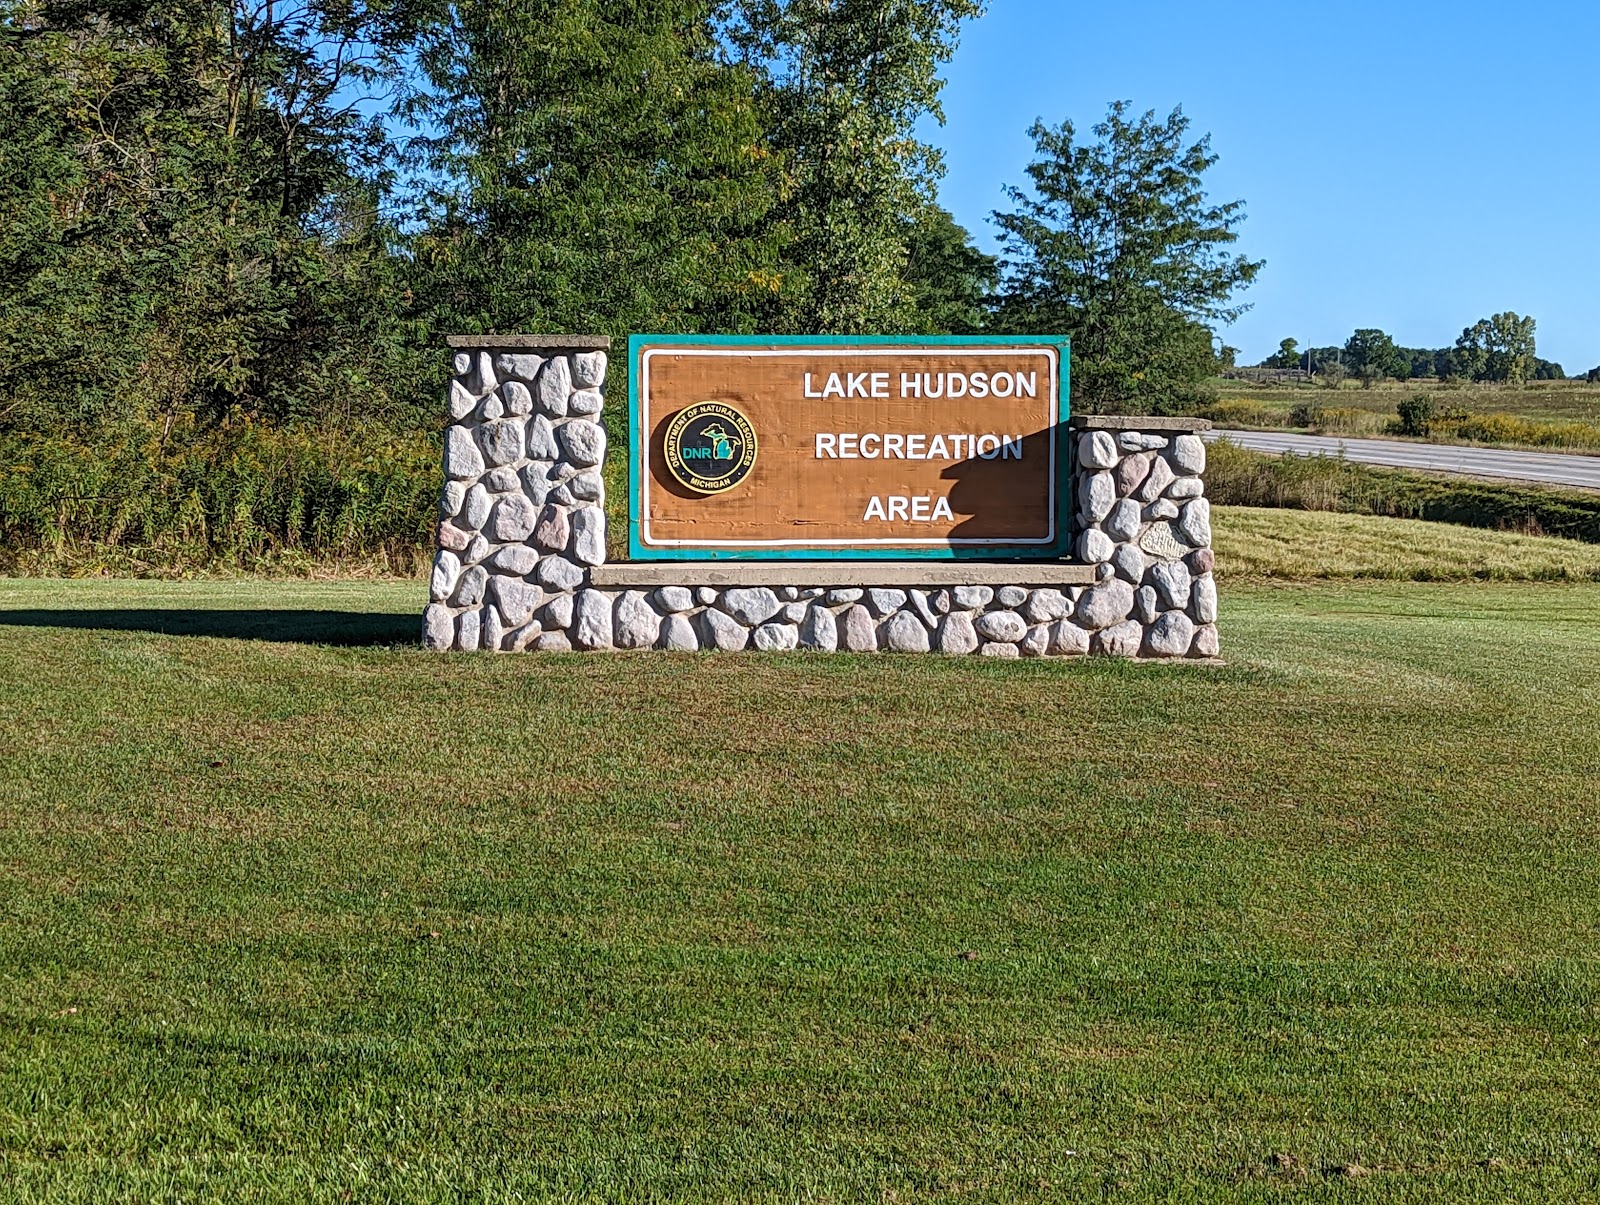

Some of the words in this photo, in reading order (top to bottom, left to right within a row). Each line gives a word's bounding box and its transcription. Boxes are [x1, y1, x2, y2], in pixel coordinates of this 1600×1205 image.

[804, 372, 890, 398] LAKE
[900, 371, 1036, 398] HUDSON
[668, 416, 688, 468] DEPARTMENT
[687, 408, 698, 418] OF
[700, 405, 736, 420] NATURAL
[736, 417, 754, 467] RESOURCES
[815, 433, 1022, 460] RECREATION
[683, 447, 712, 459] DNR
[690, 477, 731, 488] MICHIGAN
[863, 496, 954, 521] AREA
